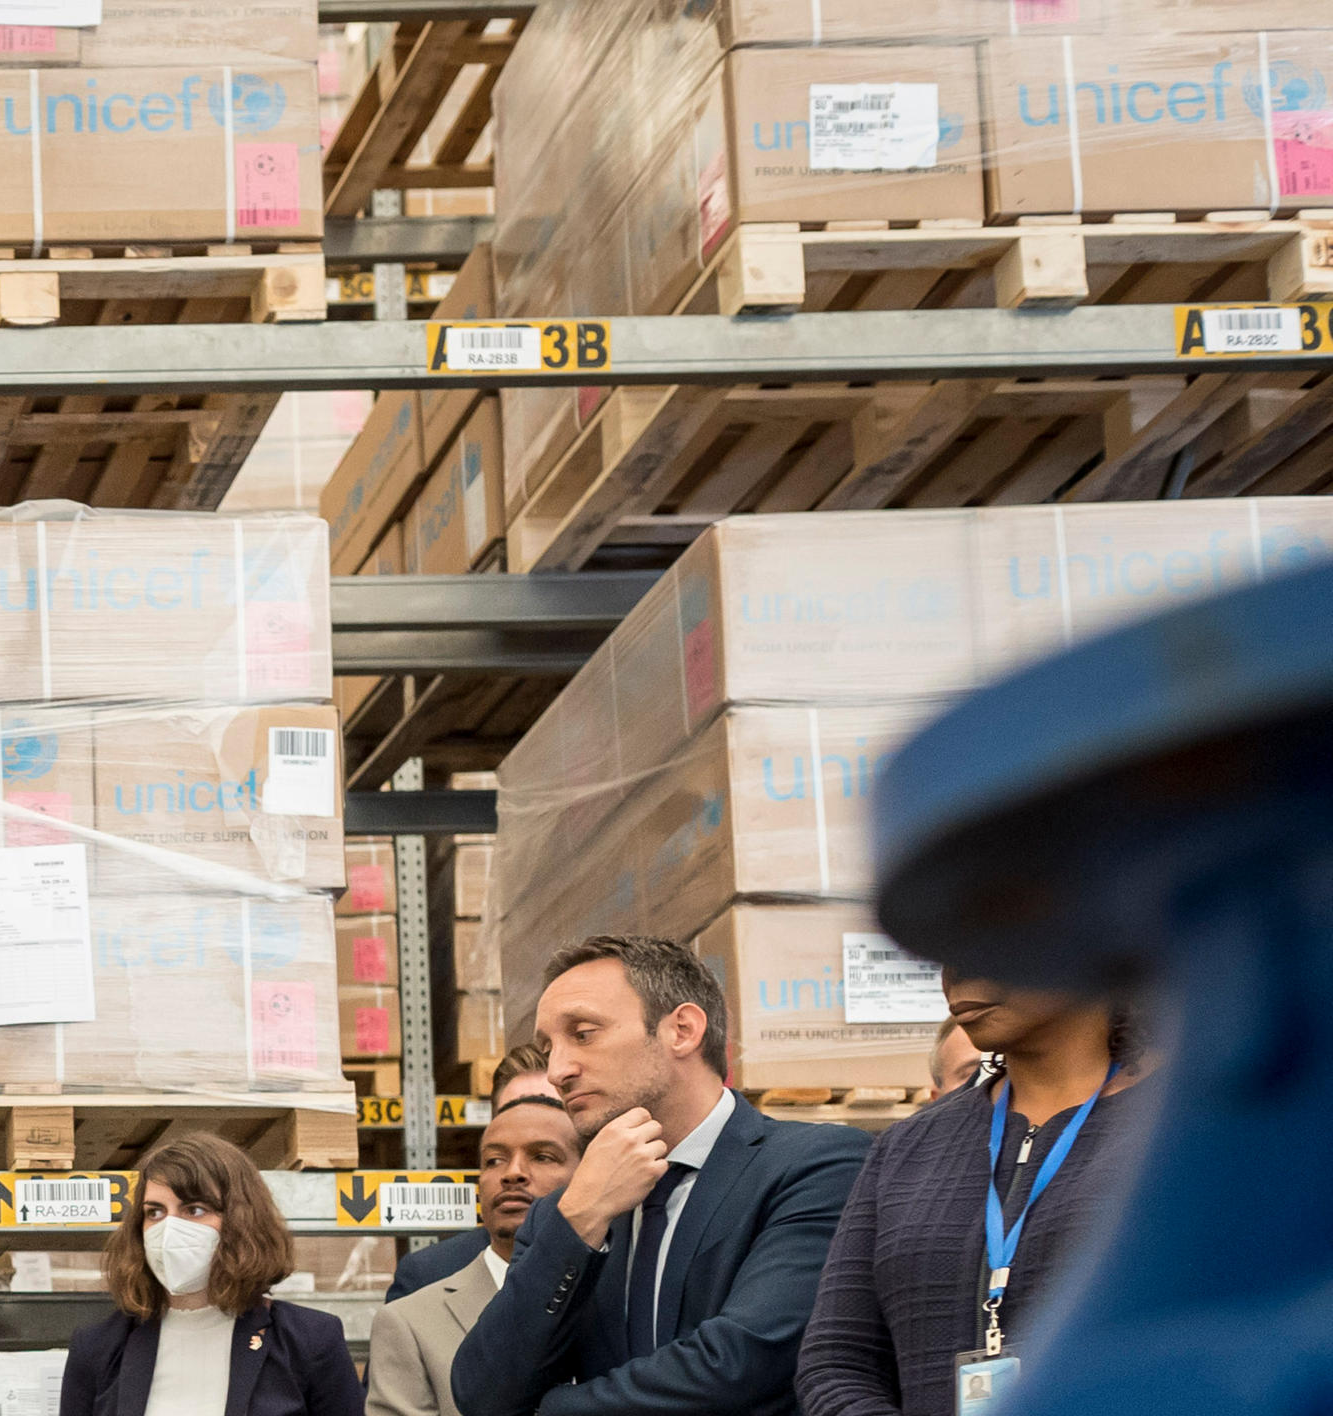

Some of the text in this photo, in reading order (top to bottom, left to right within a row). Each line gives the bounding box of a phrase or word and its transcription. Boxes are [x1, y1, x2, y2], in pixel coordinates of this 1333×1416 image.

[1019, 61, 1233, 127] unicef
[4, 76, 202, 137] unicef
[755, 166, 794, 177] FROM
[1226, 334, 1279, 347] RA-2B3C
[468, 352, 519, 366] RA-2B3B
[1007, 530, 1231, 601] unicef
[114, 768, 261, 816] unicef
[159, 831, 206, 843] UNICEF
[95, 907, 214, 968] icef
[760, 1029, 802, 1042] FROM
[34, 1205, 99, 1218] RA-2B2A
[399, 1209, 465, 1222] RA-2B1B
